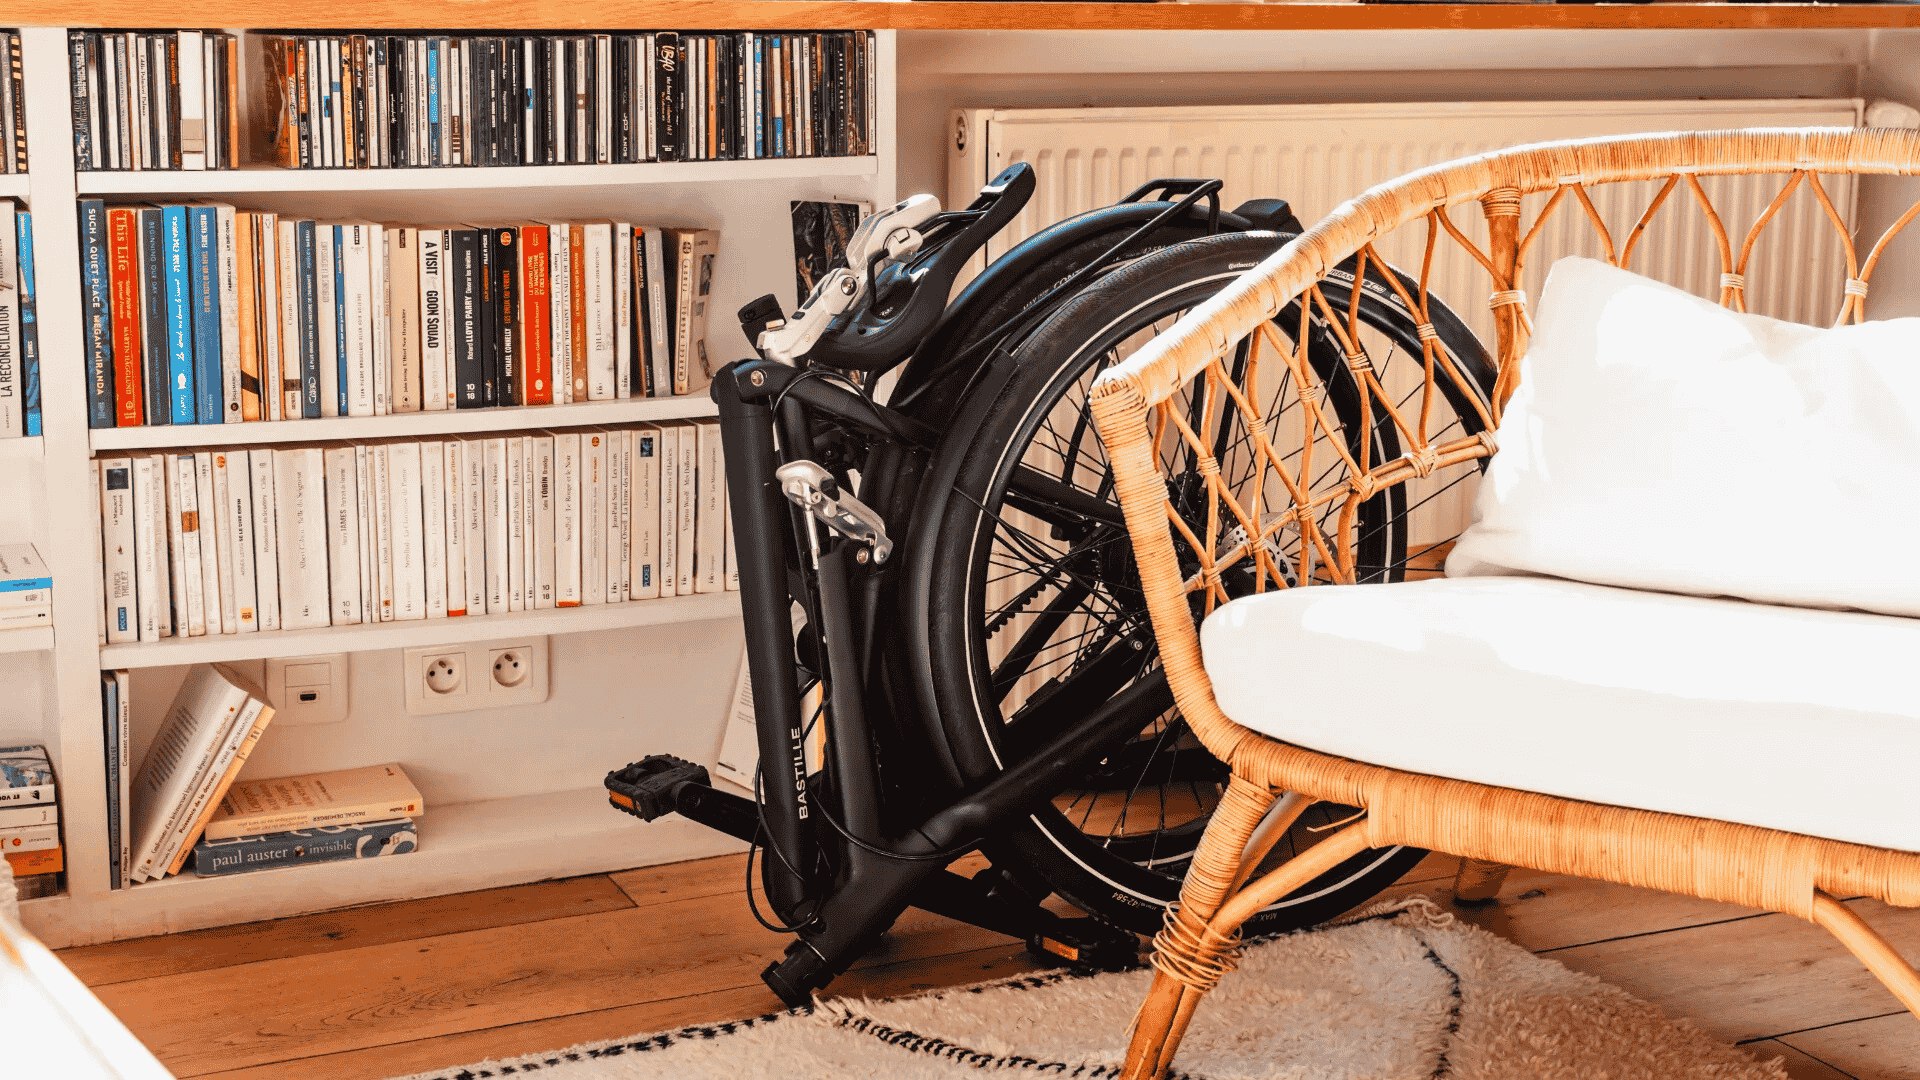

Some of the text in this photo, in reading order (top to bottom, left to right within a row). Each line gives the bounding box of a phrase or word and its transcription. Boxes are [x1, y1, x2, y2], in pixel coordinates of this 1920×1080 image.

[88, 208, 97, 235] SUCH
[116, 214, 129, 272] This Life
[425, 251, 438, 276] VISIT
[92, 278, 101, 308] PLACE
[464, 296, 473, 319] PARRY
[93, 315, 102, 349] MEGAN
[427, 290, 439, 349] GOON SQUAD
[95, 351, 104, 395] MIRANDA
[1, 385, 13, 397] LA
[790, 726, 809, 820] BASTILLE
[212, 839, 352, 871] paul auster invisible
